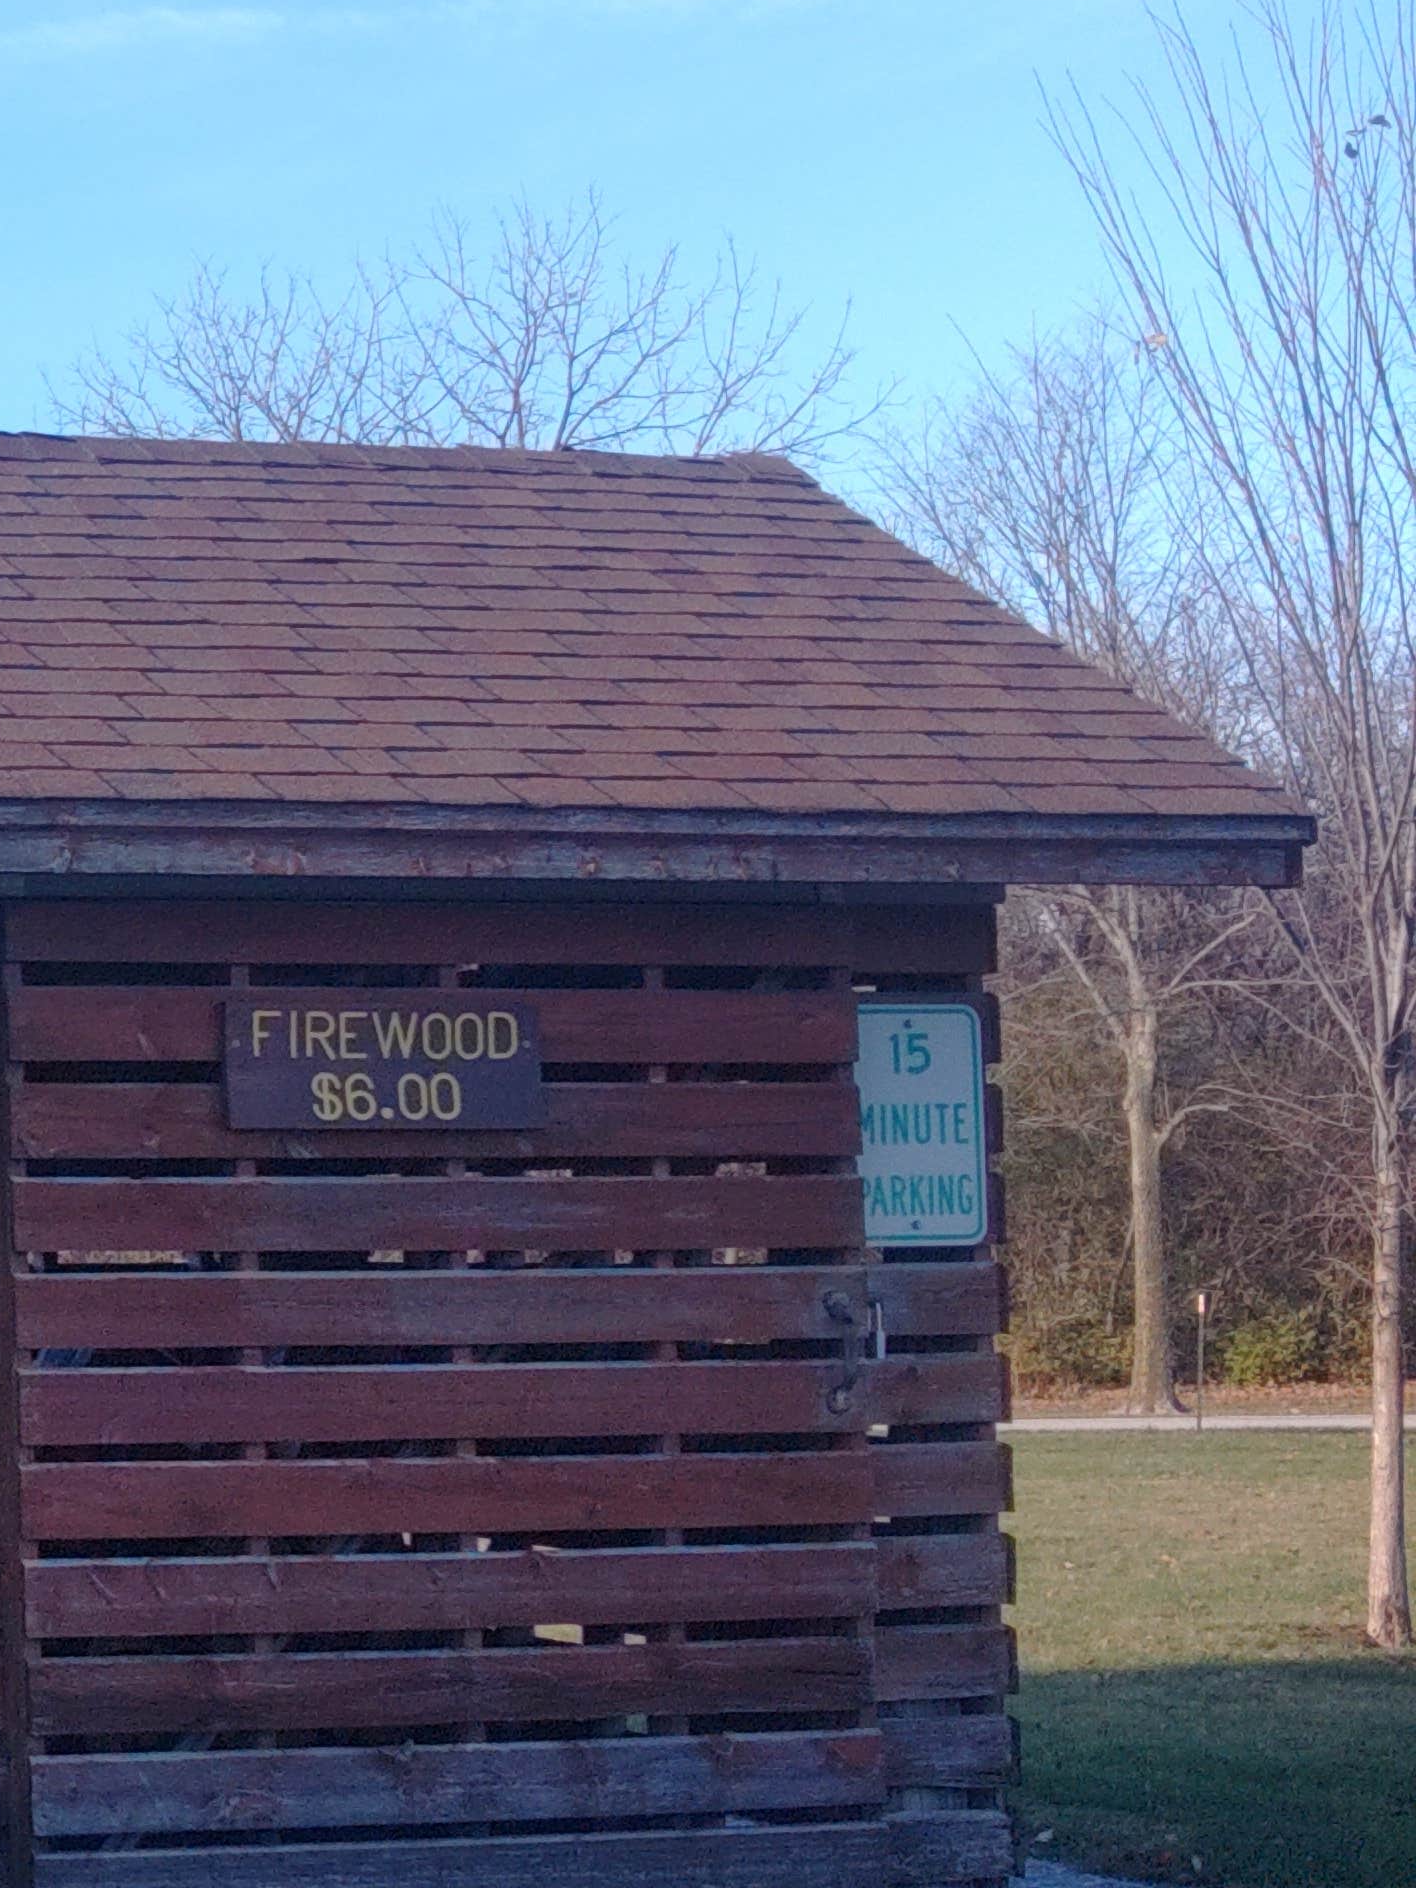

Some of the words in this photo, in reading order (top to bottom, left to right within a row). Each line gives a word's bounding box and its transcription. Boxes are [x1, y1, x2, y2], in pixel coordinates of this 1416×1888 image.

[251, 1010, 518, 1061] FIREWOOD
[889, 1032, 932, 1075] 15
[311, 1071, 462, 1121] $6.00
